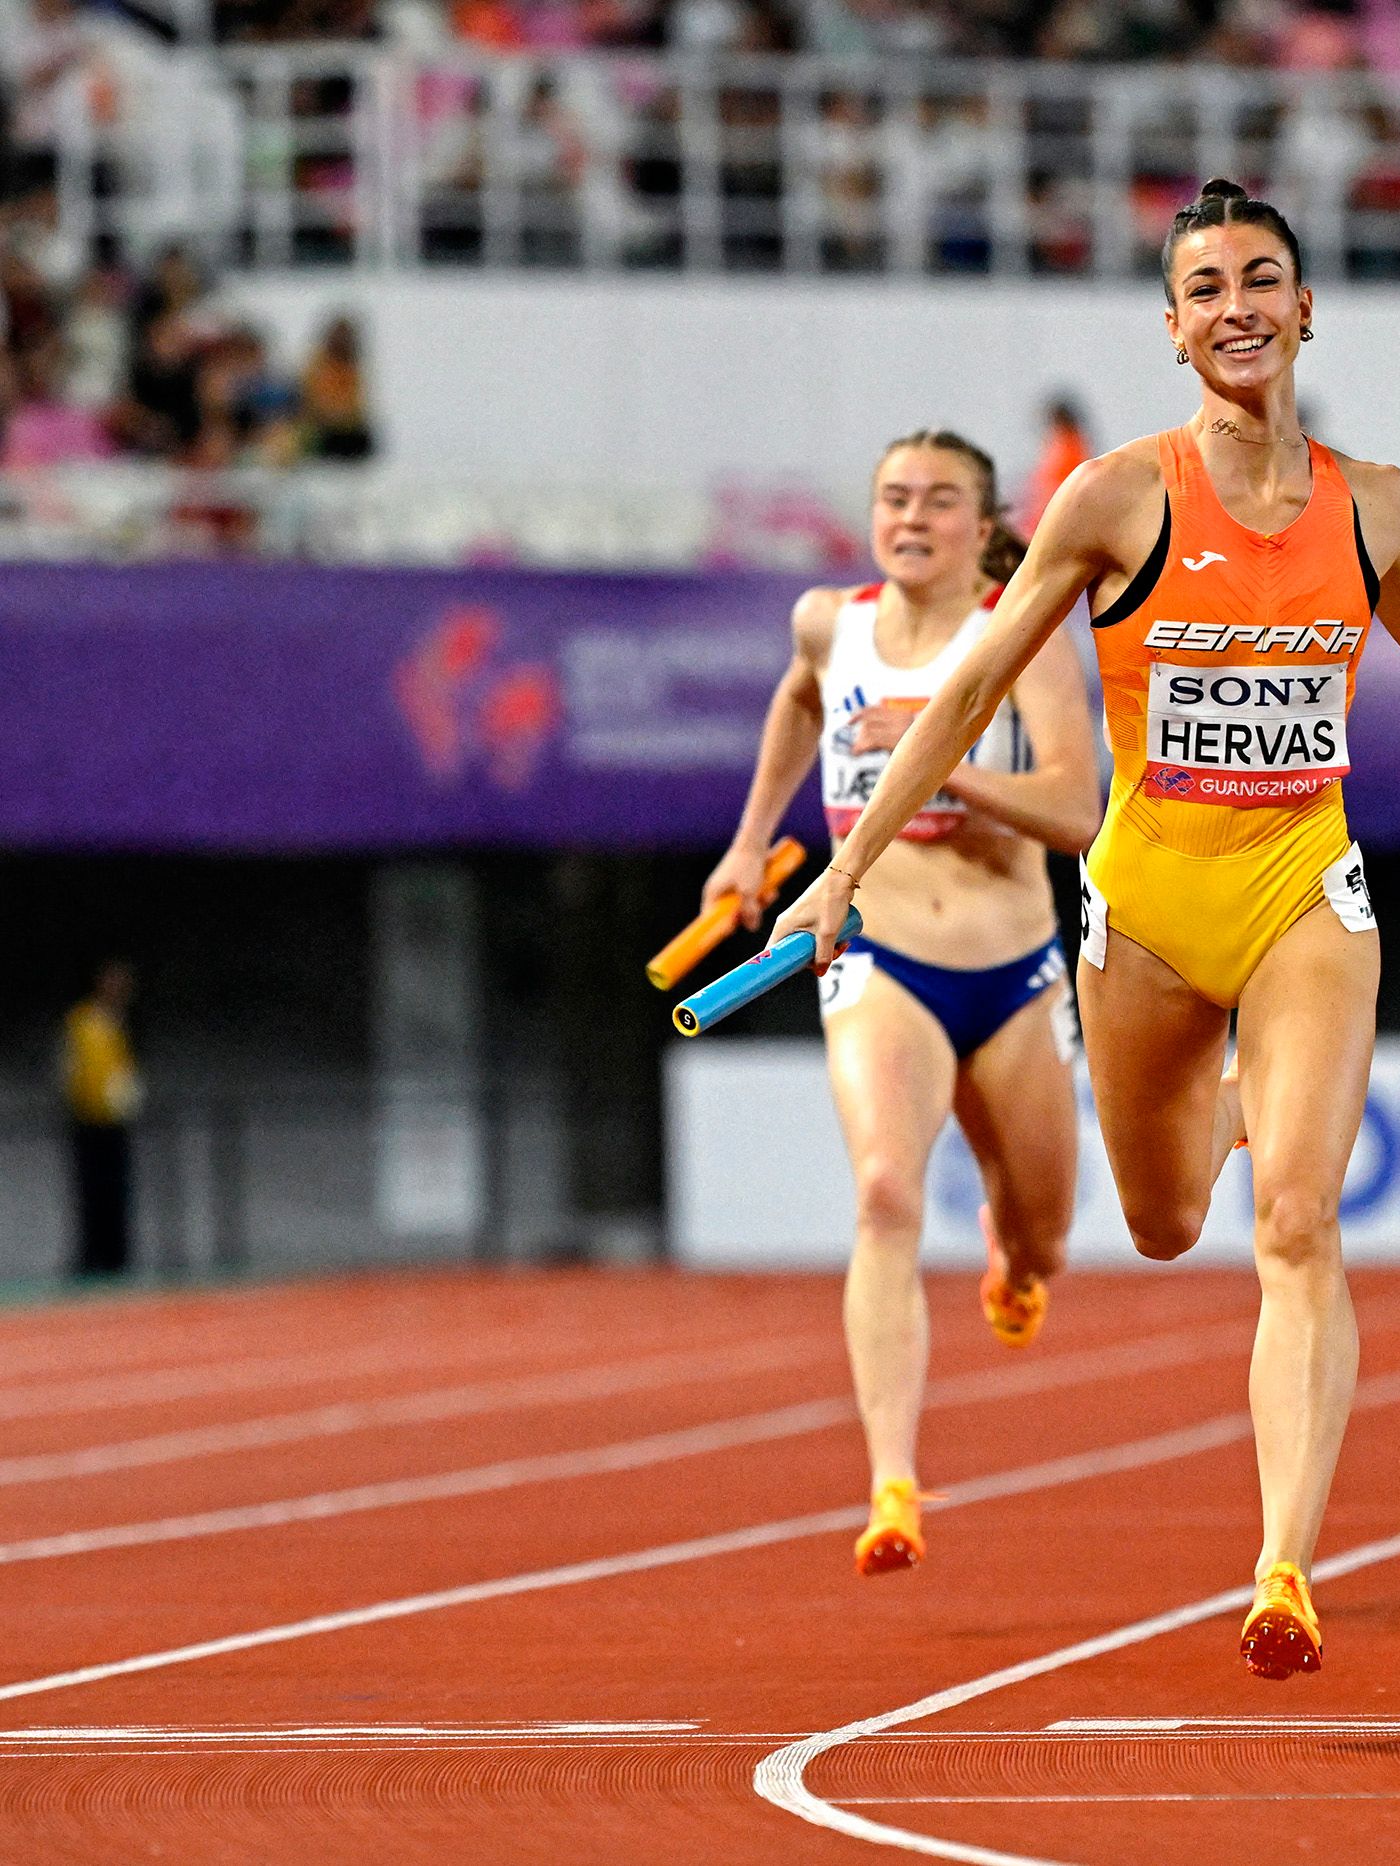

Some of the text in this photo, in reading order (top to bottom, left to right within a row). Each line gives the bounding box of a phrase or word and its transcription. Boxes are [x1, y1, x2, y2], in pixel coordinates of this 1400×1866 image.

[1143, 618, 1365, 654] ESPAÑA
[1168, 675, 1332, 707] SONY
[1160, 718, 1336, 766] HERVAS
[1199, 776, 1318, 798] GUANGZHOU
